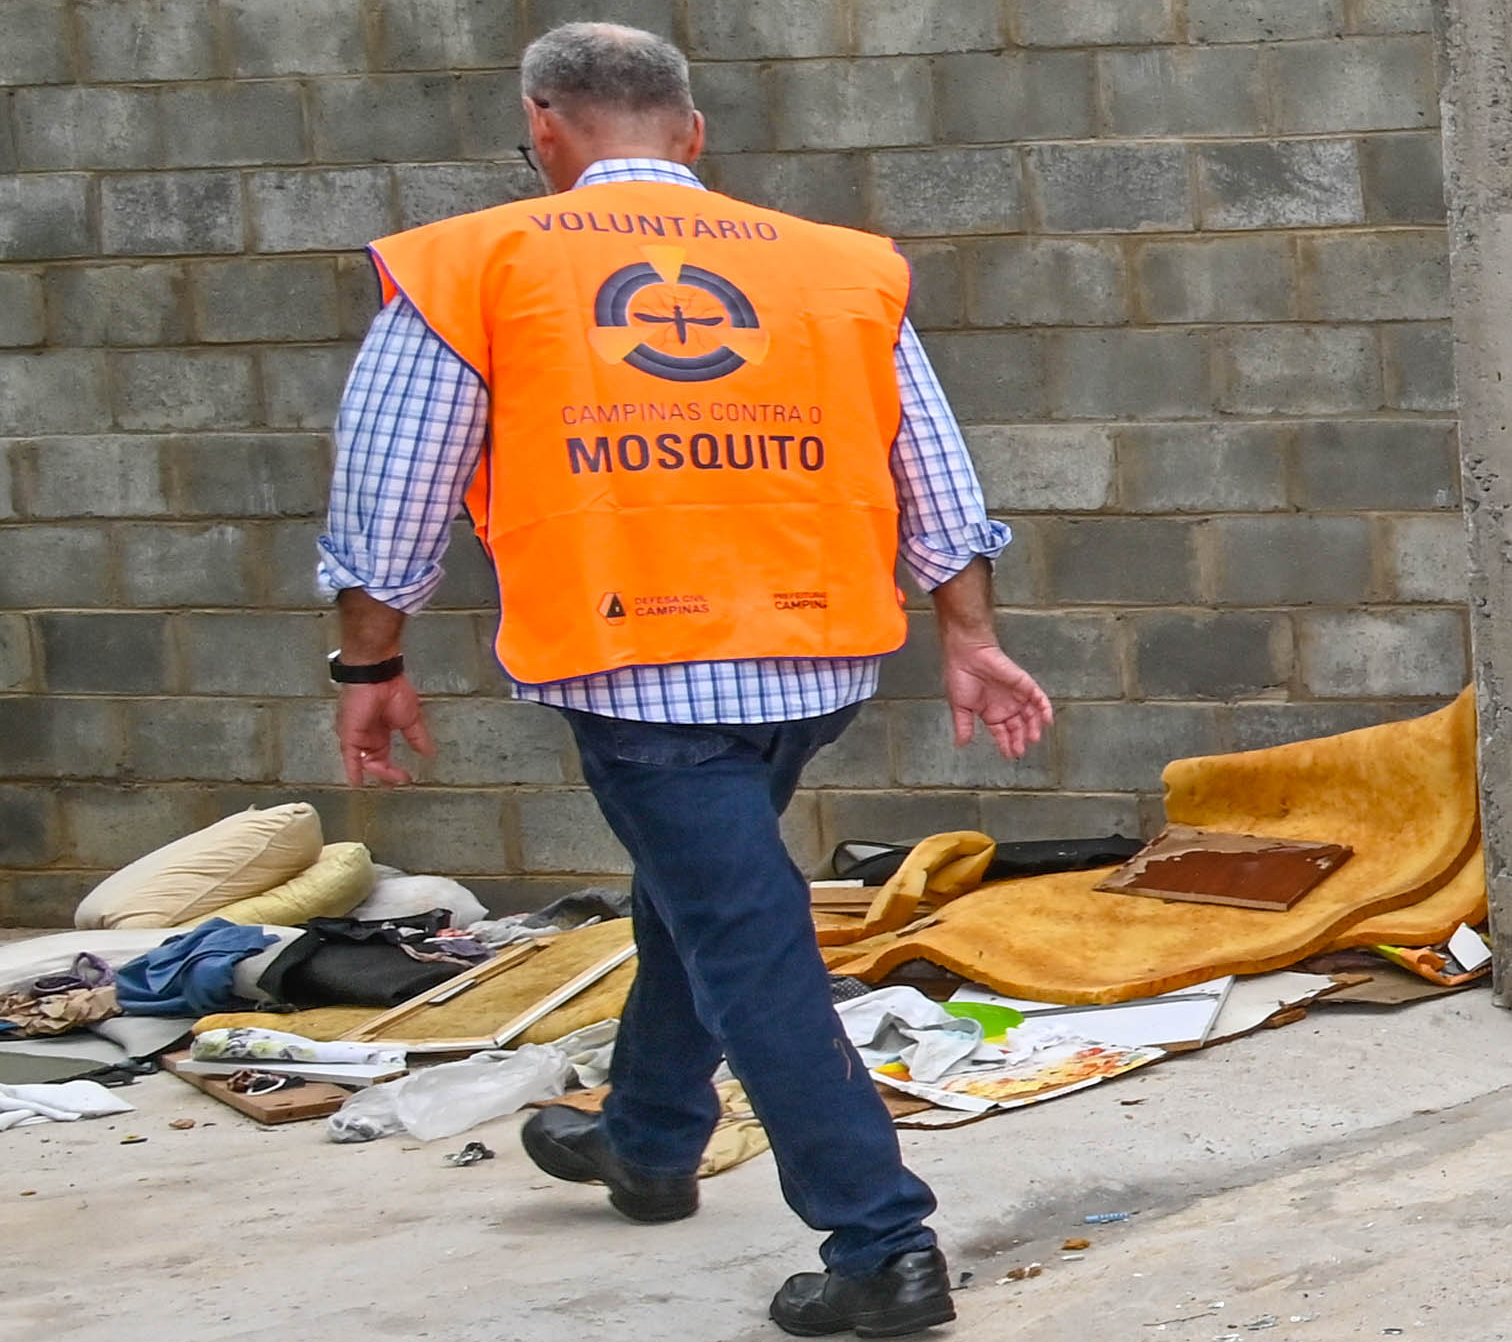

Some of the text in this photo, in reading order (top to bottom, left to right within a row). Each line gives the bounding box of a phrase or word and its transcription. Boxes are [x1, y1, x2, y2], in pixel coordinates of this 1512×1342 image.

[529, 212, 779, 241] VOLUNTÁRIO
[562, 402, 823, 425] CAMPINAS CONTRA O
[566, 433, 825, 475] MOSQUITO
[634, 604, 710, 617] CAMPINAS
